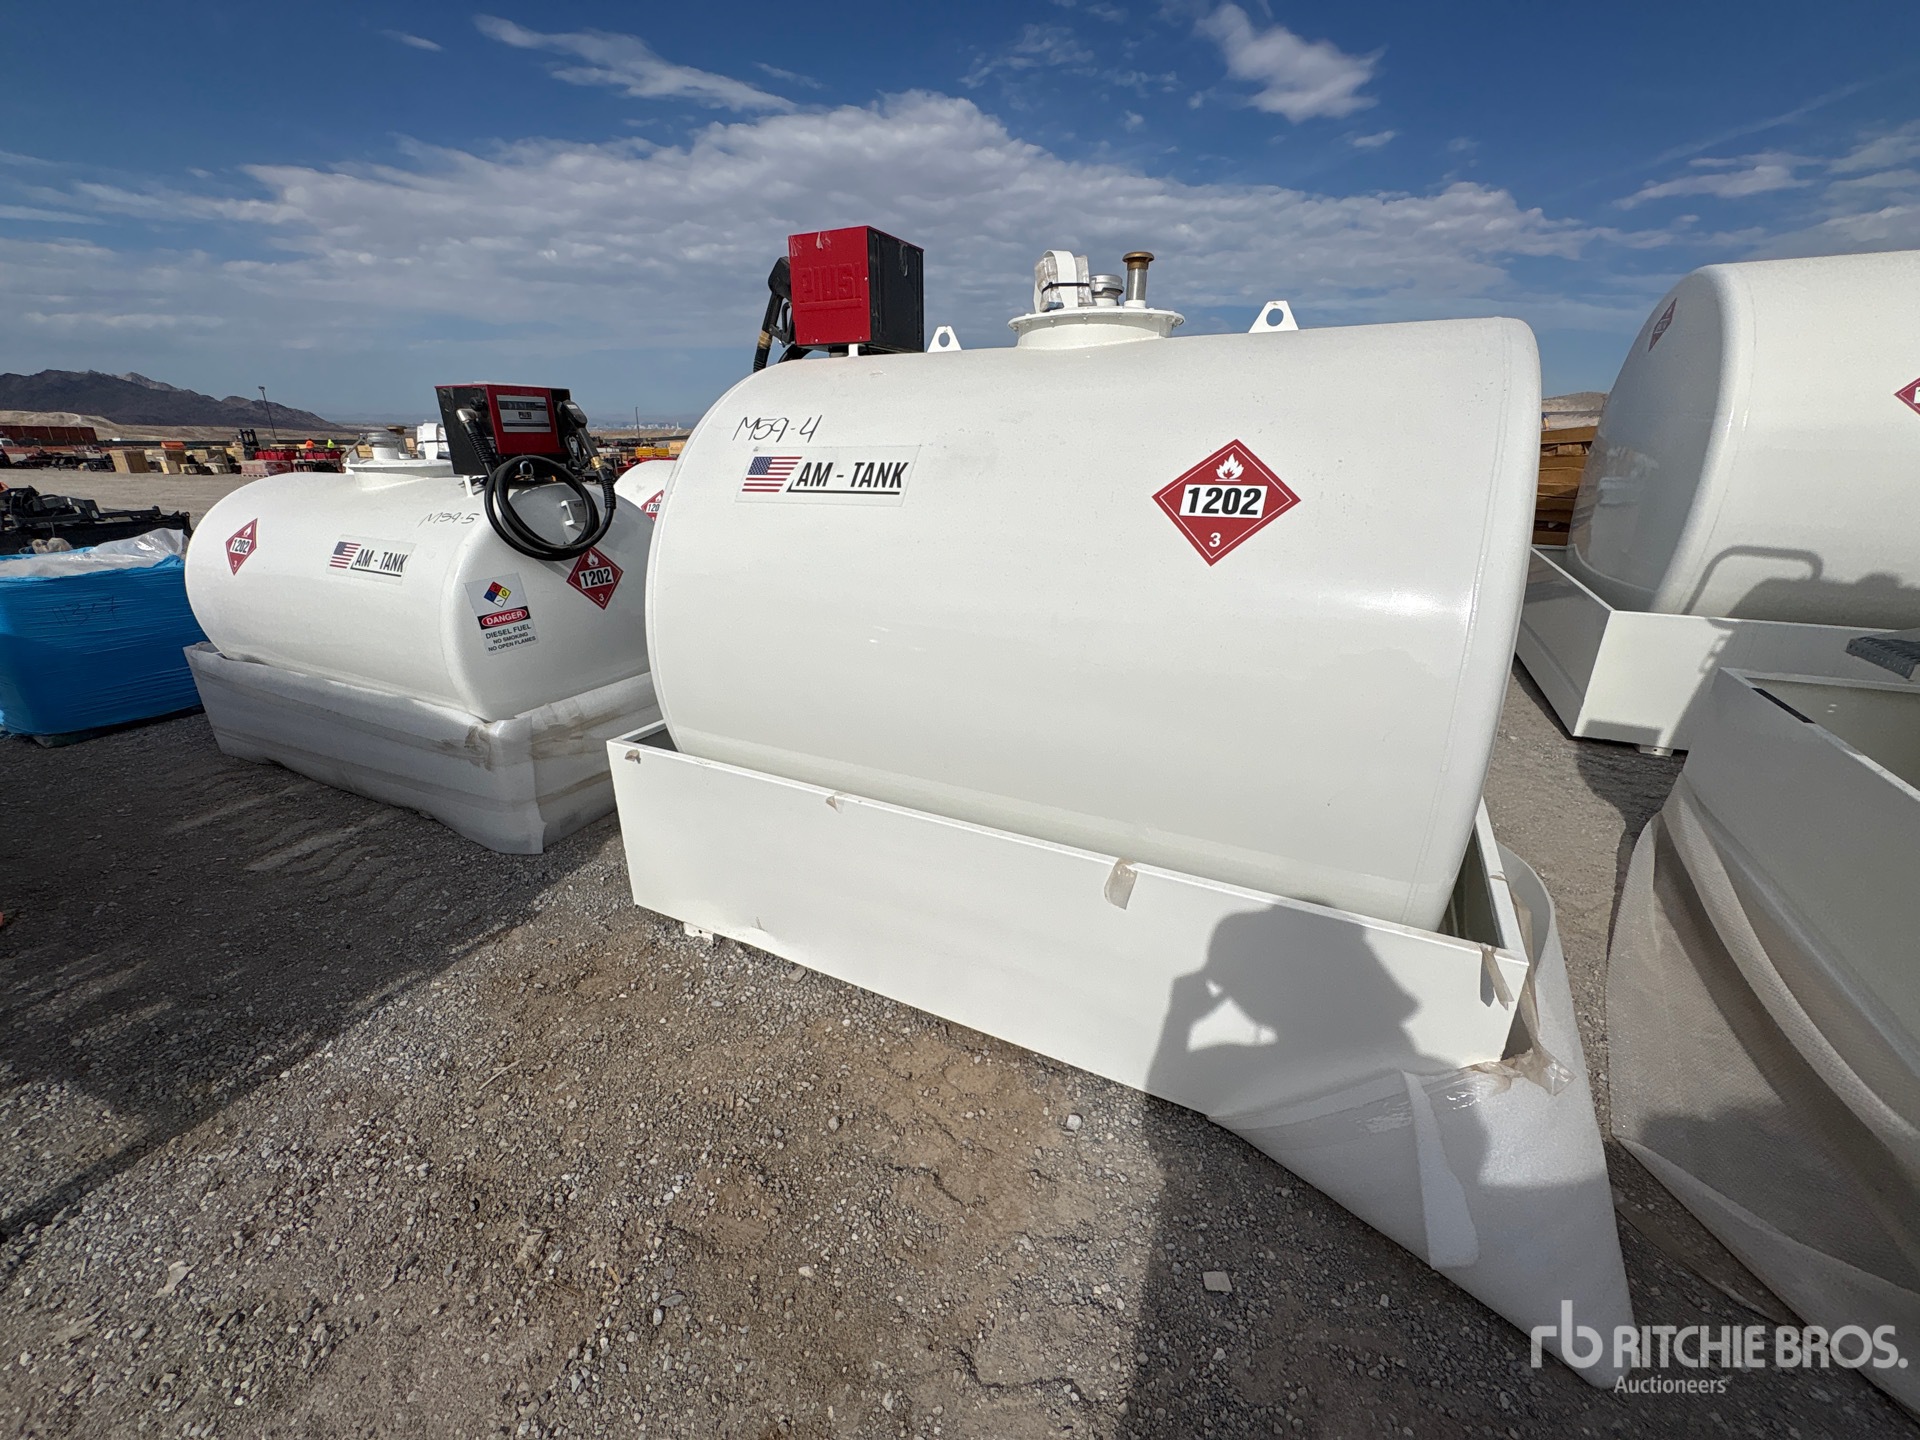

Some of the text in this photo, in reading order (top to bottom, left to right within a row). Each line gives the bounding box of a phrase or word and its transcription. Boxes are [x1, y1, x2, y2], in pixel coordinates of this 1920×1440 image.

[732, 415, 823, 443] M59-4
[796, 462, 833, 487] AM
[850, 462, 909, 488] TANK
[648, 503, 660, 512] 120
[1187, 487, 1262, 515] 1202
[231, 539, 251, 554] 1202
[1208, 532, 1221, 547] 3
[233, 560, 238, 568] 3
[355, 549, 373, 567] AM
[379, 551, 408, 573] TANK
[580, 568, 613, 587] 1202
[501, 589, 508, 597] 0
[598, 593, 605, 602] 3
[486, 610, 524, 626] DANGER
[485, 623, 532, 640] DIESEL FUEL
[493, 631, 529, 645] NO SMOKING
[488, 635, 537, 652] NO OPEN FLAMES
